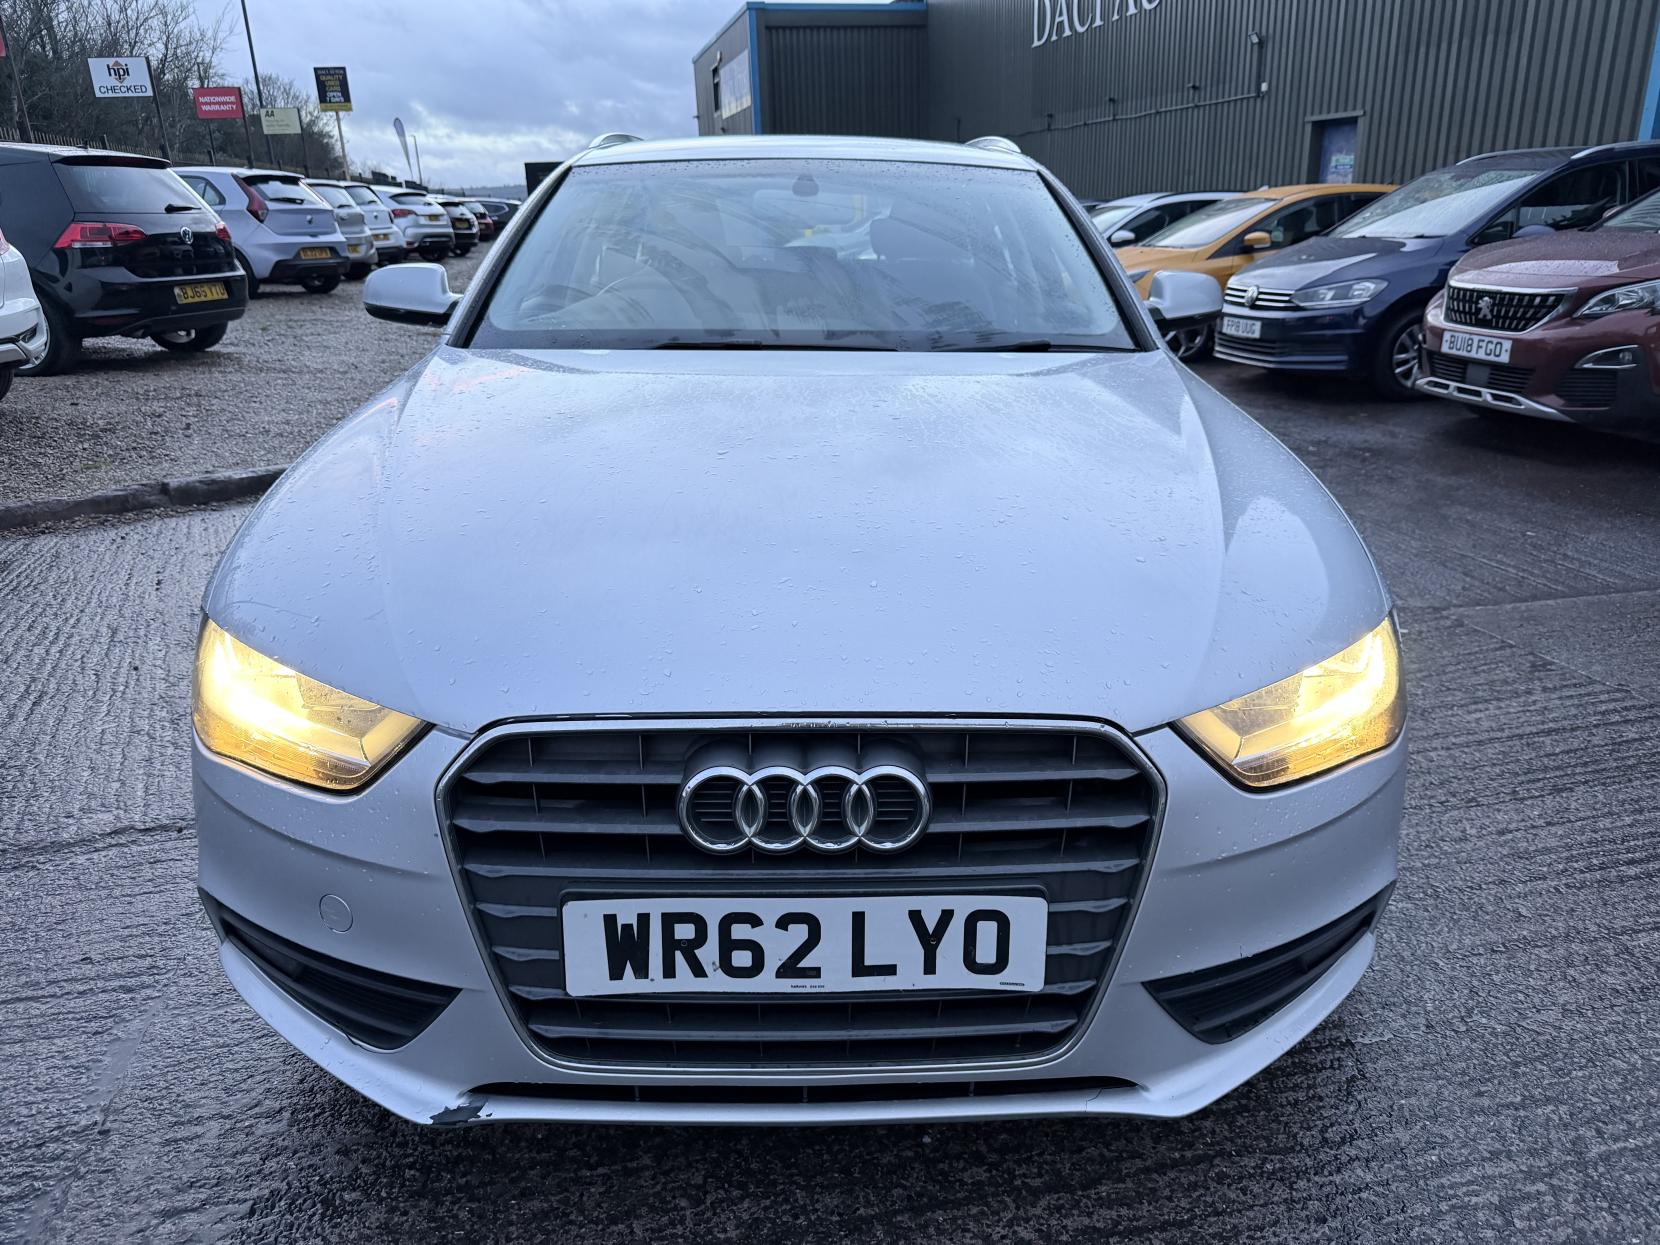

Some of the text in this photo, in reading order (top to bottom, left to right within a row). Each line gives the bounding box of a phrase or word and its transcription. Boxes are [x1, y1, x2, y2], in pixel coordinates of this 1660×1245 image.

[106, 63, 130, 81] hpi
[98, 85, 148, 95] CHECKED
[264, 110, 275, 118] AA
[1448, 334, 1503, 358] BU18 FGO
[603, 908, 1011, 982] WR62 LYO
